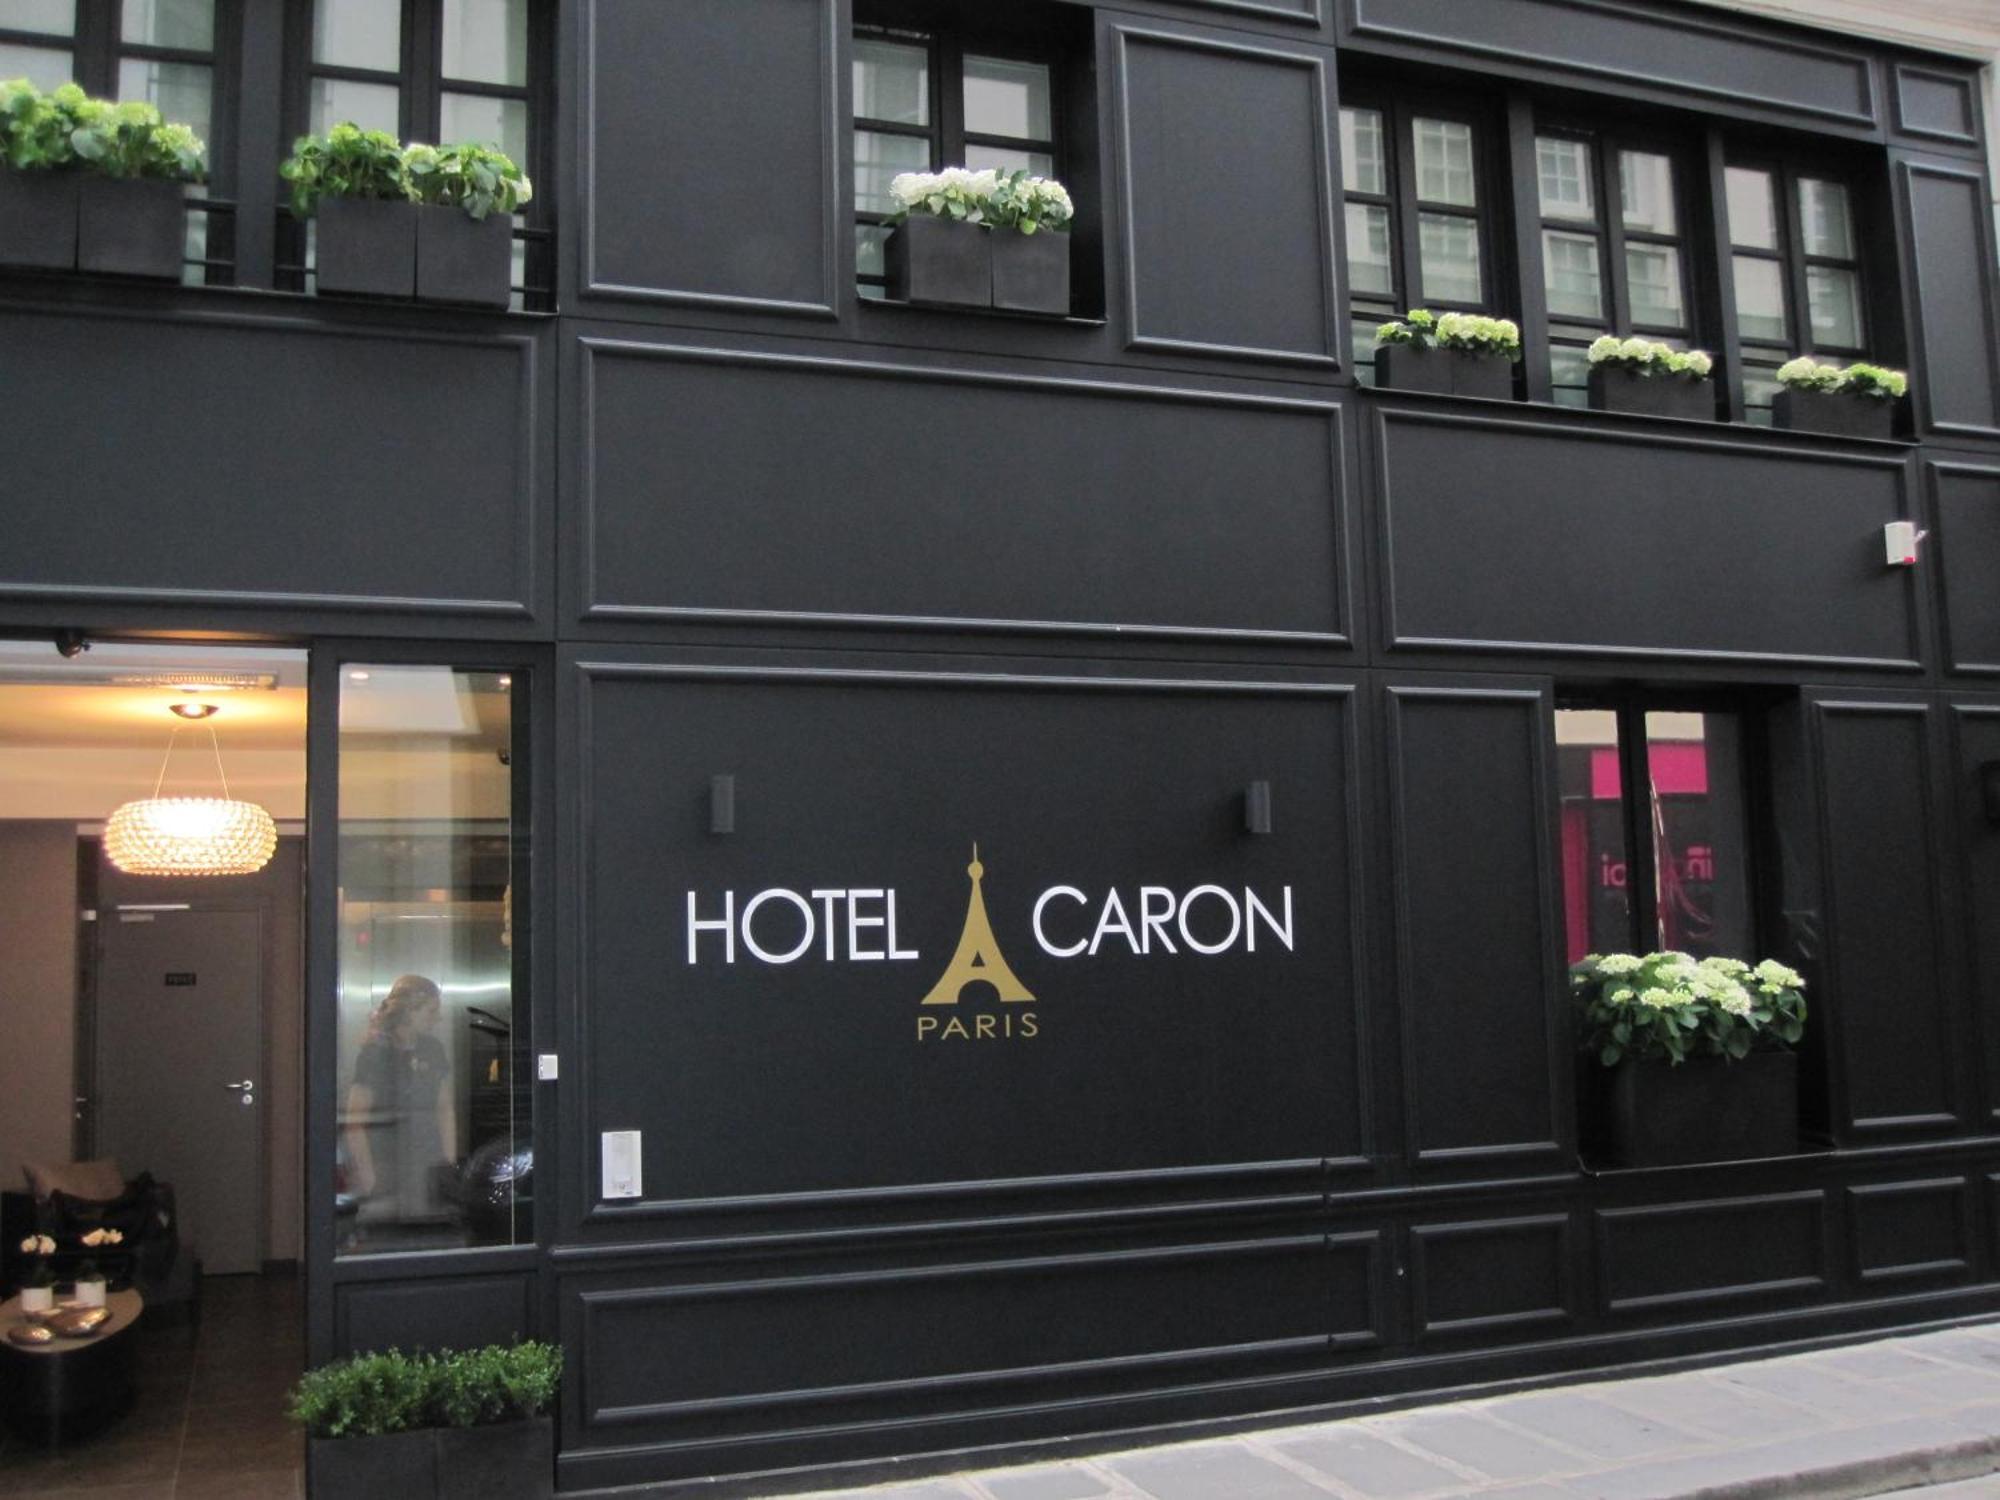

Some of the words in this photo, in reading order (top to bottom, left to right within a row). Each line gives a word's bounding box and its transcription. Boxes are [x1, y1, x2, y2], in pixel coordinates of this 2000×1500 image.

[686, 887, 920, 965] HOTEL
[1032, 884, 1295, 959] CARON
[917, 1012, 1039, 1041] PARIS
